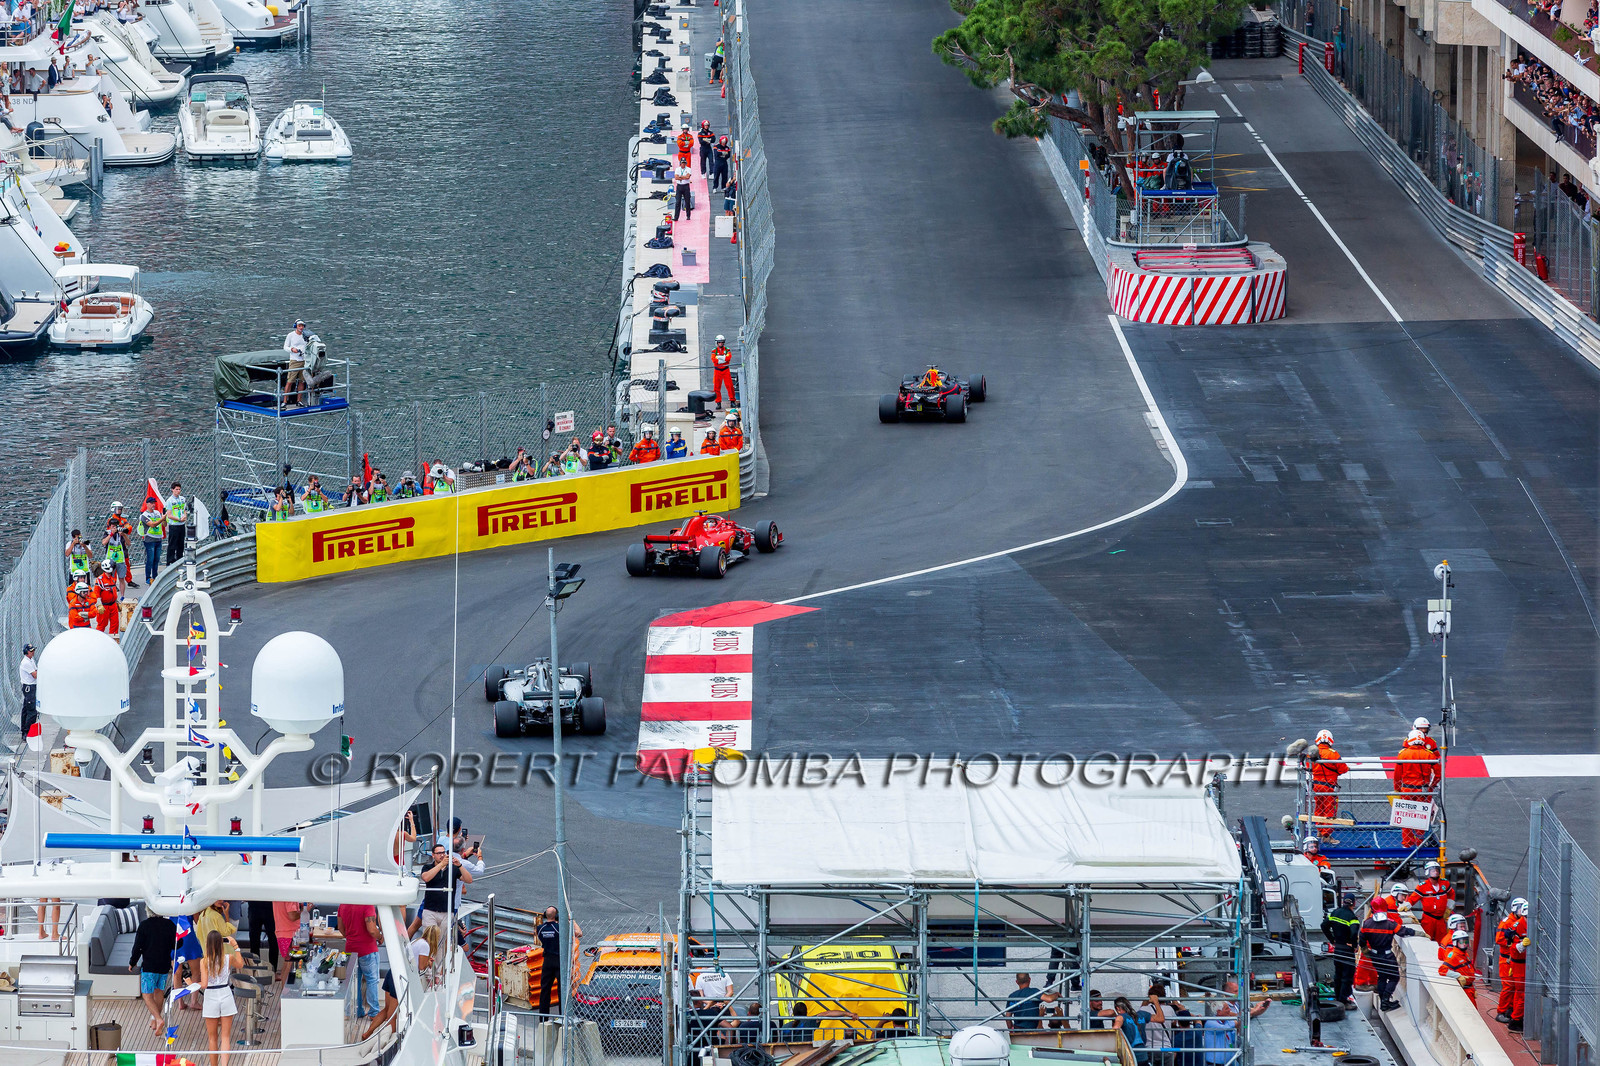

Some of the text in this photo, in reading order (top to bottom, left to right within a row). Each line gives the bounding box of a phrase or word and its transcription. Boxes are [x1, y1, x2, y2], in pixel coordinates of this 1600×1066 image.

[631, 470, 728, 513] PIRELLI
[478, 493, 577, 536] PIRELLI
[313, 517, 415, 562] PIRELLI
[713, 637, 739, 652] UBS
[711, 683, 738, 698] UBS
[708, 731, 737, 748] UBS
[1395, 802, 1417, 810] SECTEUR
[1393, 816, 1402, 824] 10
[1394, 811, 1427, 820] INTERVENTION
